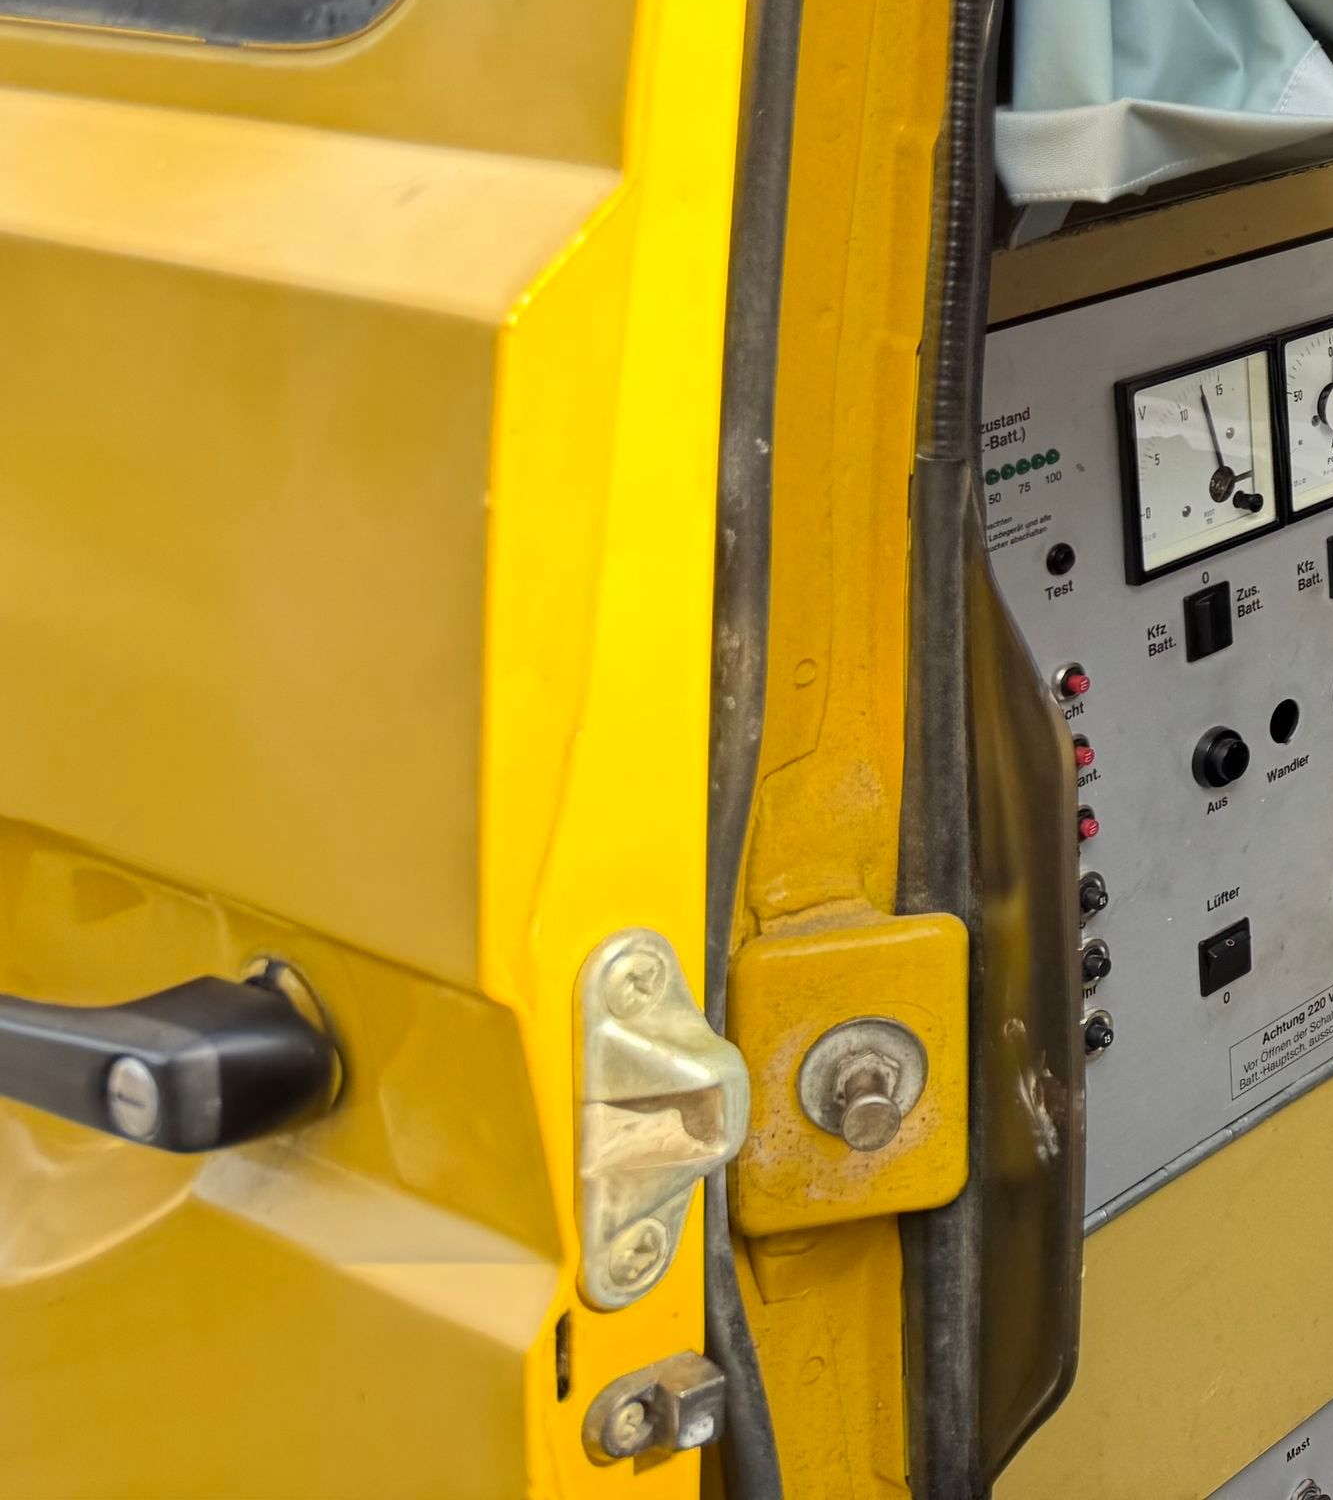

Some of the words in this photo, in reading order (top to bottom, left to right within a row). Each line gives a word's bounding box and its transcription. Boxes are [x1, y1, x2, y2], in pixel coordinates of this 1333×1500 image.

[1215, 383, 1223, 396] 15
[1293, 390, 1303, 402] 50
[1138, 405, 1147, 420] V
[1180, 409, 1189, 422] 10
[1154, 453, 1160, 466] 5
[988, 492, 1001, 505] 50
[1018, 482, 1031, 494] 75
[1045, 470, 1062, 484] 100
[1202, 571, 1209, 584] 0
[1297, 560, 1315, 576] Kfz
[1044, 580, 1074, 600] Test
[1298, 572, 1323, 591] Batt.
[1236, 585, 1260, 602] Zus.
[1237, 598, 1264, 618] Batt.
[1147, 623, 1167, 641] Kfz
[1148, 637, 1177, 657] Batt.
[1267, 754, 1310, 783] Wandler
[1207, 796, 1228, 815] Aus
[1207, 886, 1240, 912] Lüfter
[1223, 992, 1230, 1004] 0
[1262, 1012, 1305, 1045] Achtung
[1307, 997, 1326, 1018] 220
[1244, 1058, 1259, 1074] Vor
[1260, 1038, 1292, 1064] Öffnen
[1293, 1027, 1309, 1045] der
[1286, 1437, 1310, 1463] Mast
